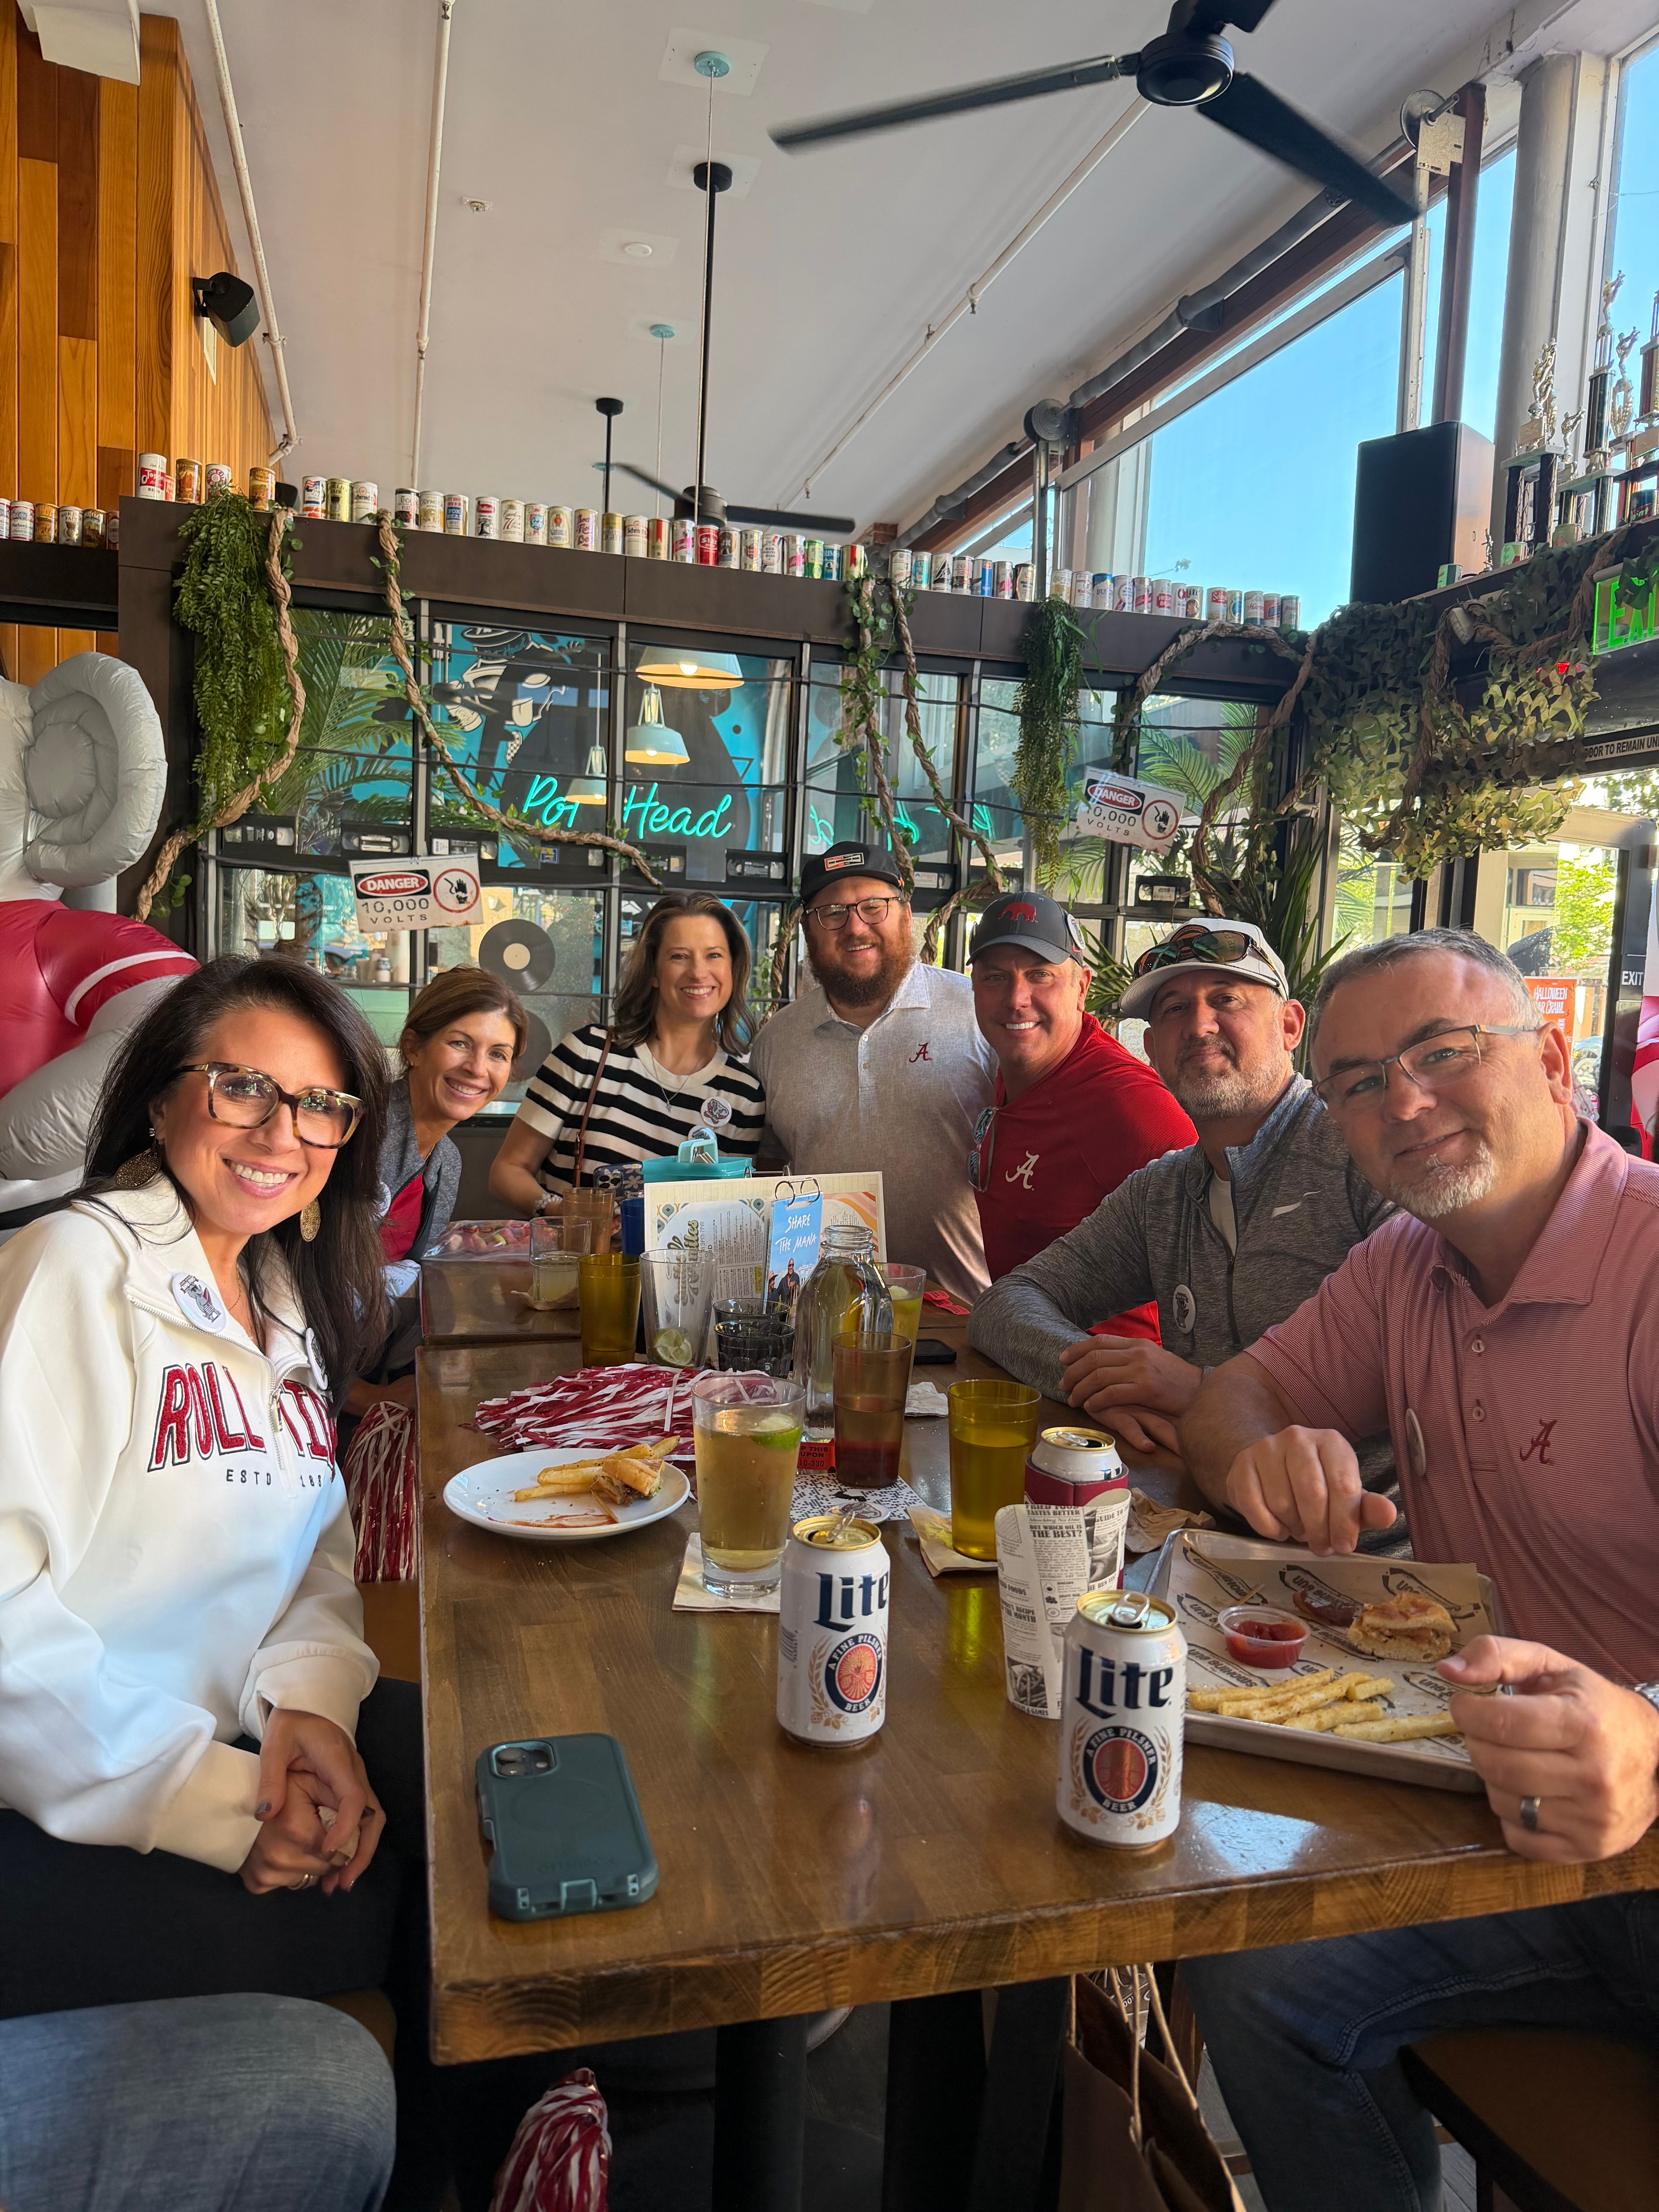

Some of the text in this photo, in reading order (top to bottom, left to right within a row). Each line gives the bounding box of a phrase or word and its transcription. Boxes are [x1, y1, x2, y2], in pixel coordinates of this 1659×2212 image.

[1605, 744, 1615, 754] TO
[1616, 738, 1645, 753] REMAIN
[1094, 787, 1135, 807] DANGER
[623, 783, 732, 839] Head
[1087, 819, 1130, 836] VOLTS
[366, 877, 420, 891] DANGER
[362, 898, 429, 914] 10,000
[370, 914, 427, 924] VOLTS
[1622, 971, 1644, 986] EXIT
[1534, 985, 1568, 1001] HALLOWEEN
[1546, 1000, 1565, 1015] CRAWL
[1005, 1150, 1040, 1190] A
[785, 1214, 811, 1233] SHARE
[775, 1233, 817, 1254] THE MANA
[148, 1362, 266, 1472] ROLL
[1519, 1418, 1557, 1464] A
[226, 1469, 271, 1486] ESTD
[1053, 1529, 1082, 1538] BEST?
[813, 1570, 889, 1632] Lite
[1013, 1612, 1036, 1623] MONTH
[828, 1634, 882, 1670] A FINE PILSNER
[1075, 1644, 1174, 1719] Lite
[845, 1699, 872, 1712] BEER
[1086, 1727, 1155, 1765] A FINE PILSNER
[1103, 1798, 1137, 1812] BEER
